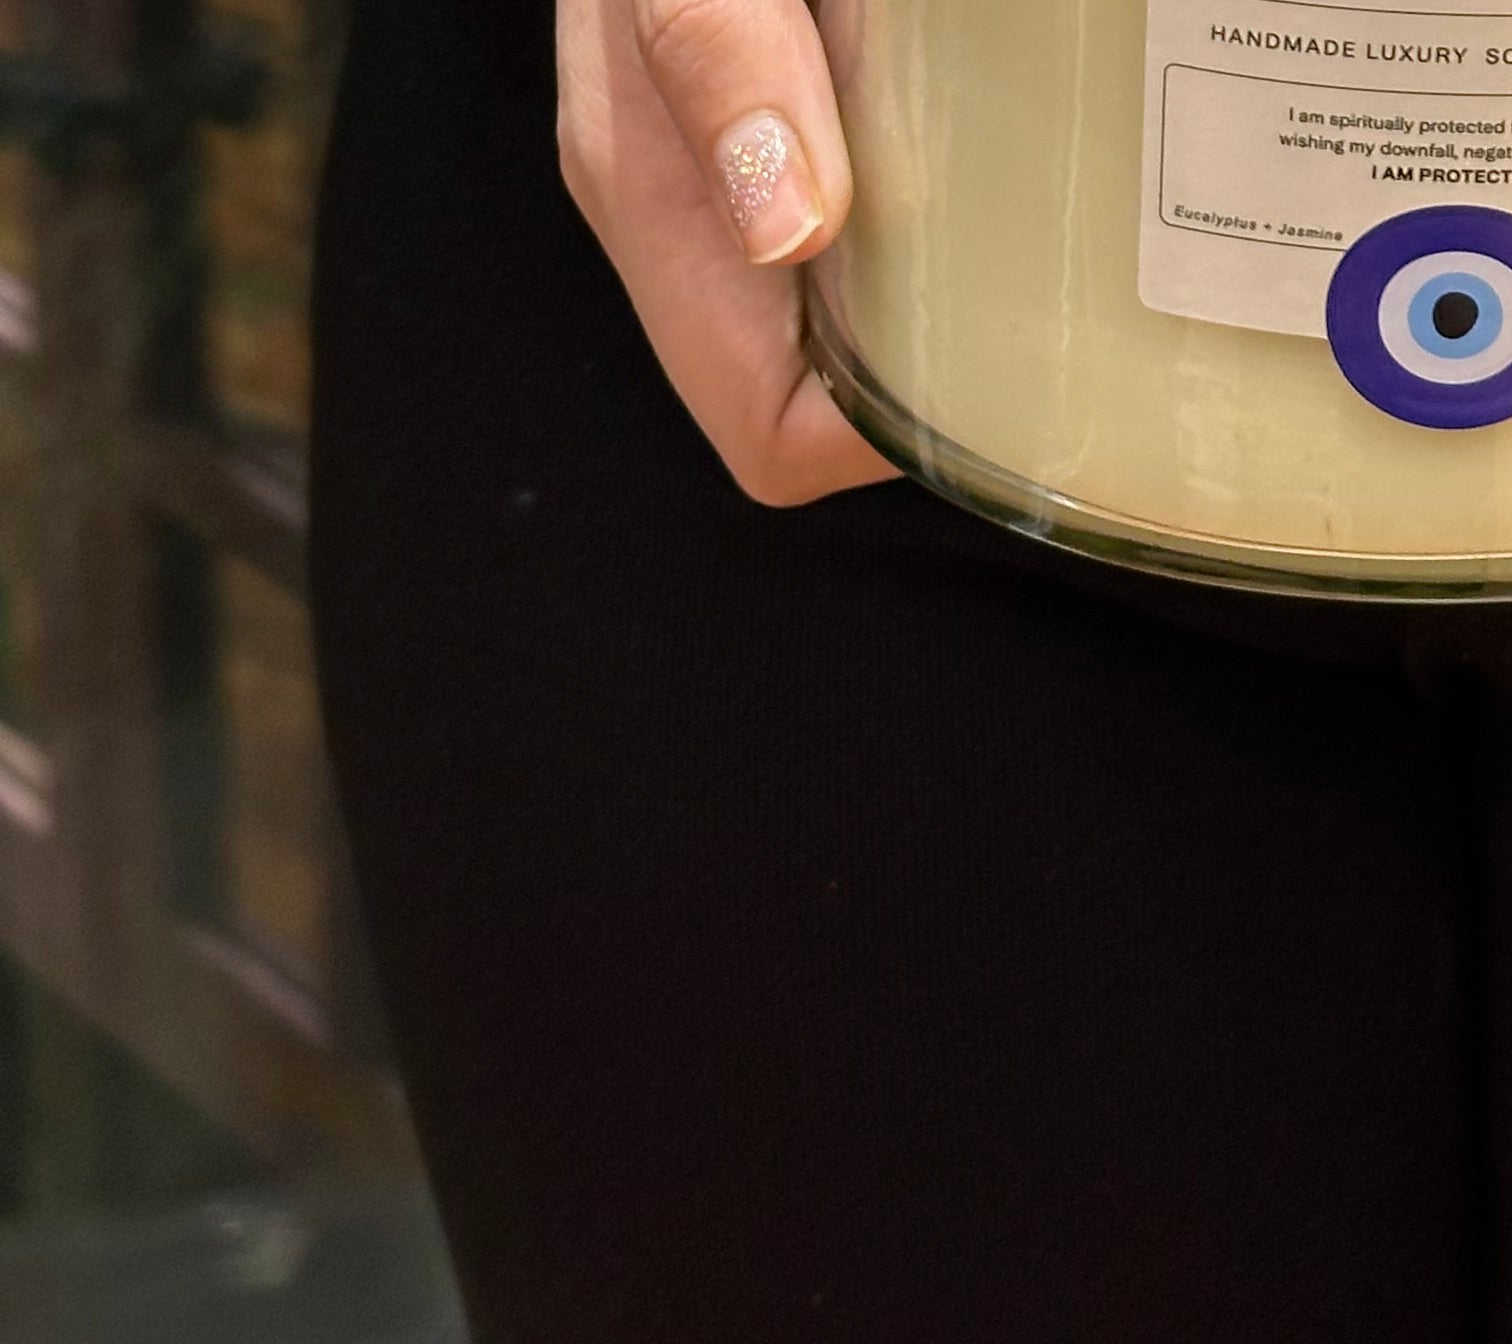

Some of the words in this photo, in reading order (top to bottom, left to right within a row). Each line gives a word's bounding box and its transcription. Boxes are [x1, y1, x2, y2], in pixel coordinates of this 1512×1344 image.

[1210, 23, 1357, 59] HANDMADE
[1365, 42, 1469, 65] LUXURY
[1288, 106, 1295, 123] I
[1297, 111, 1326, 126] am
[1328, 112, 1416, 136] spiritually
[1418, 118, 1507, 137] protected
[1278, 131, 1346, 156] wishing
[1348, 141, 1376, 158] my
[1371, 164, 1378, 181] I
[1380, 165, 1416, 183] AM
[1171, 204, 1258, 234] Eucalyptus
[1275, 223, 1344, 245] Jasmine
